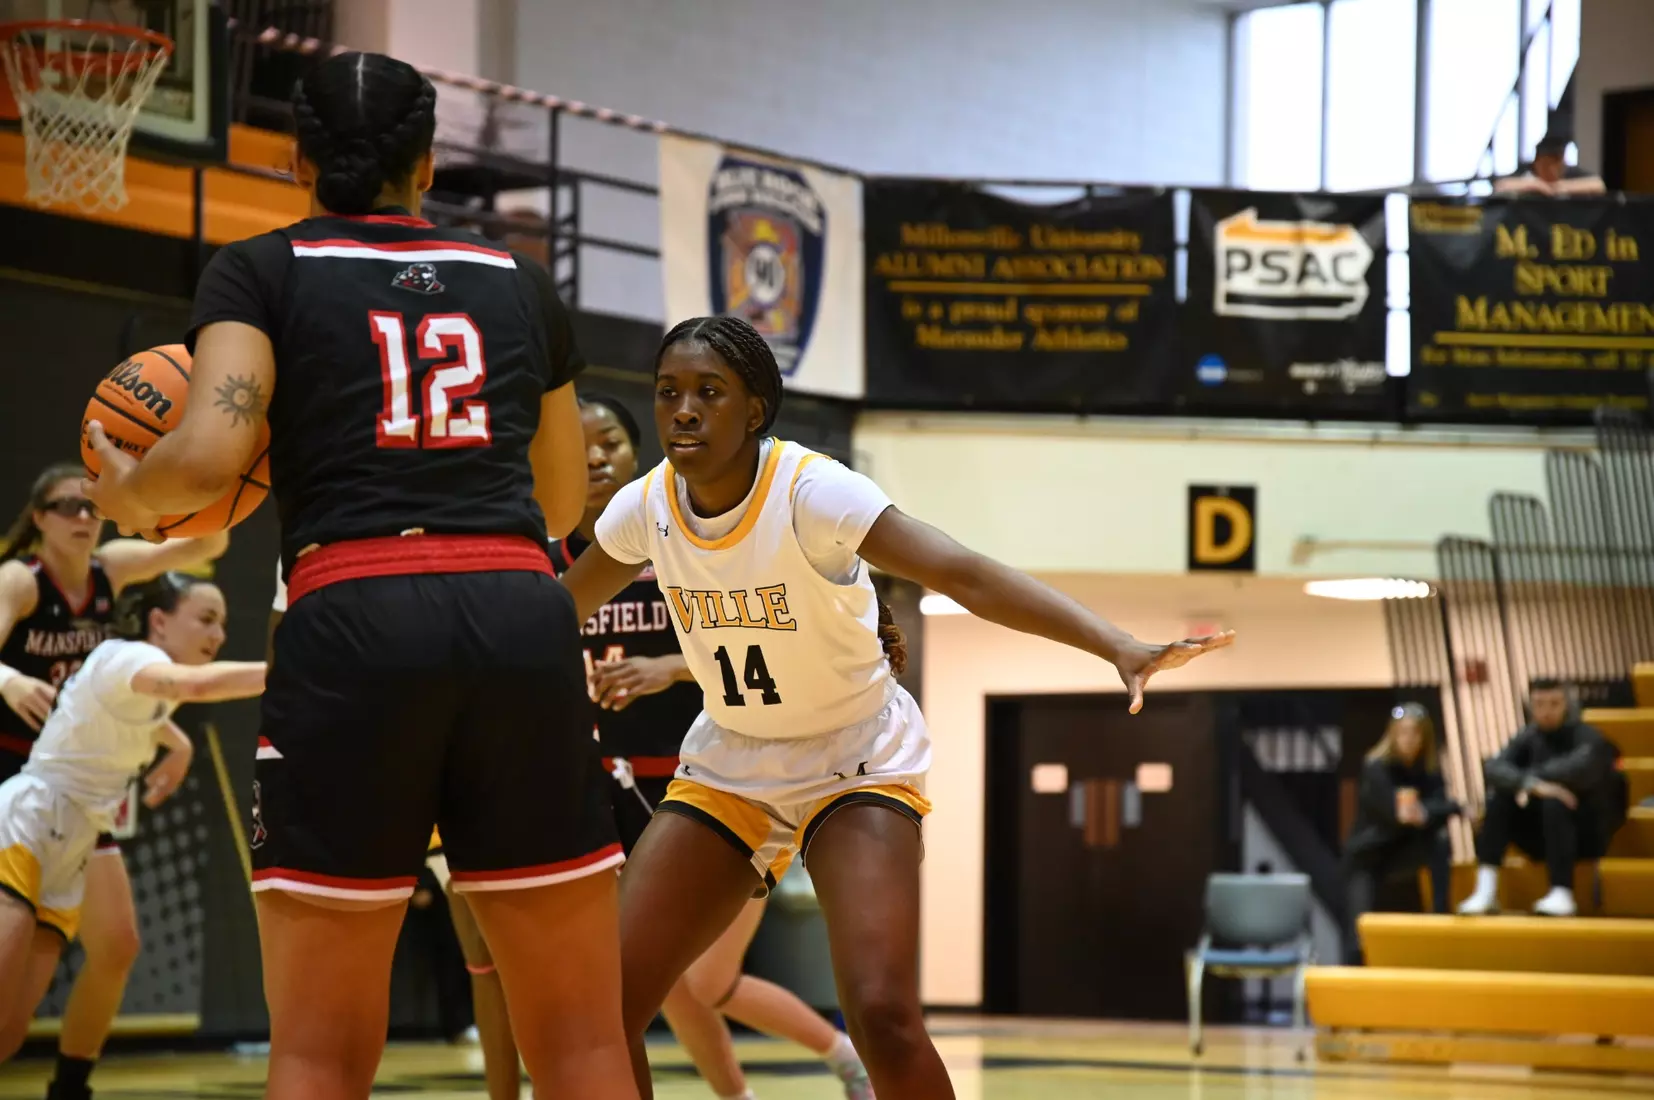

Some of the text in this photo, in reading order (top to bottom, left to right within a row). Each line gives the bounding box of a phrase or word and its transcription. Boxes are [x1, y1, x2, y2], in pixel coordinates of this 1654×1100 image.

[1606, 227, 1639, 261] in
[1226, 248, 1359, 286] PSAC
[1515, 261, 1613, 296] SPORT
[368, 309, 492, 449] 12
[1194, 496, 1252, 564] D
[580, 601, 668, 636] SFIELD
[667, 584, 796, 633] VILLE
[714, 645, 782, 706] 14
